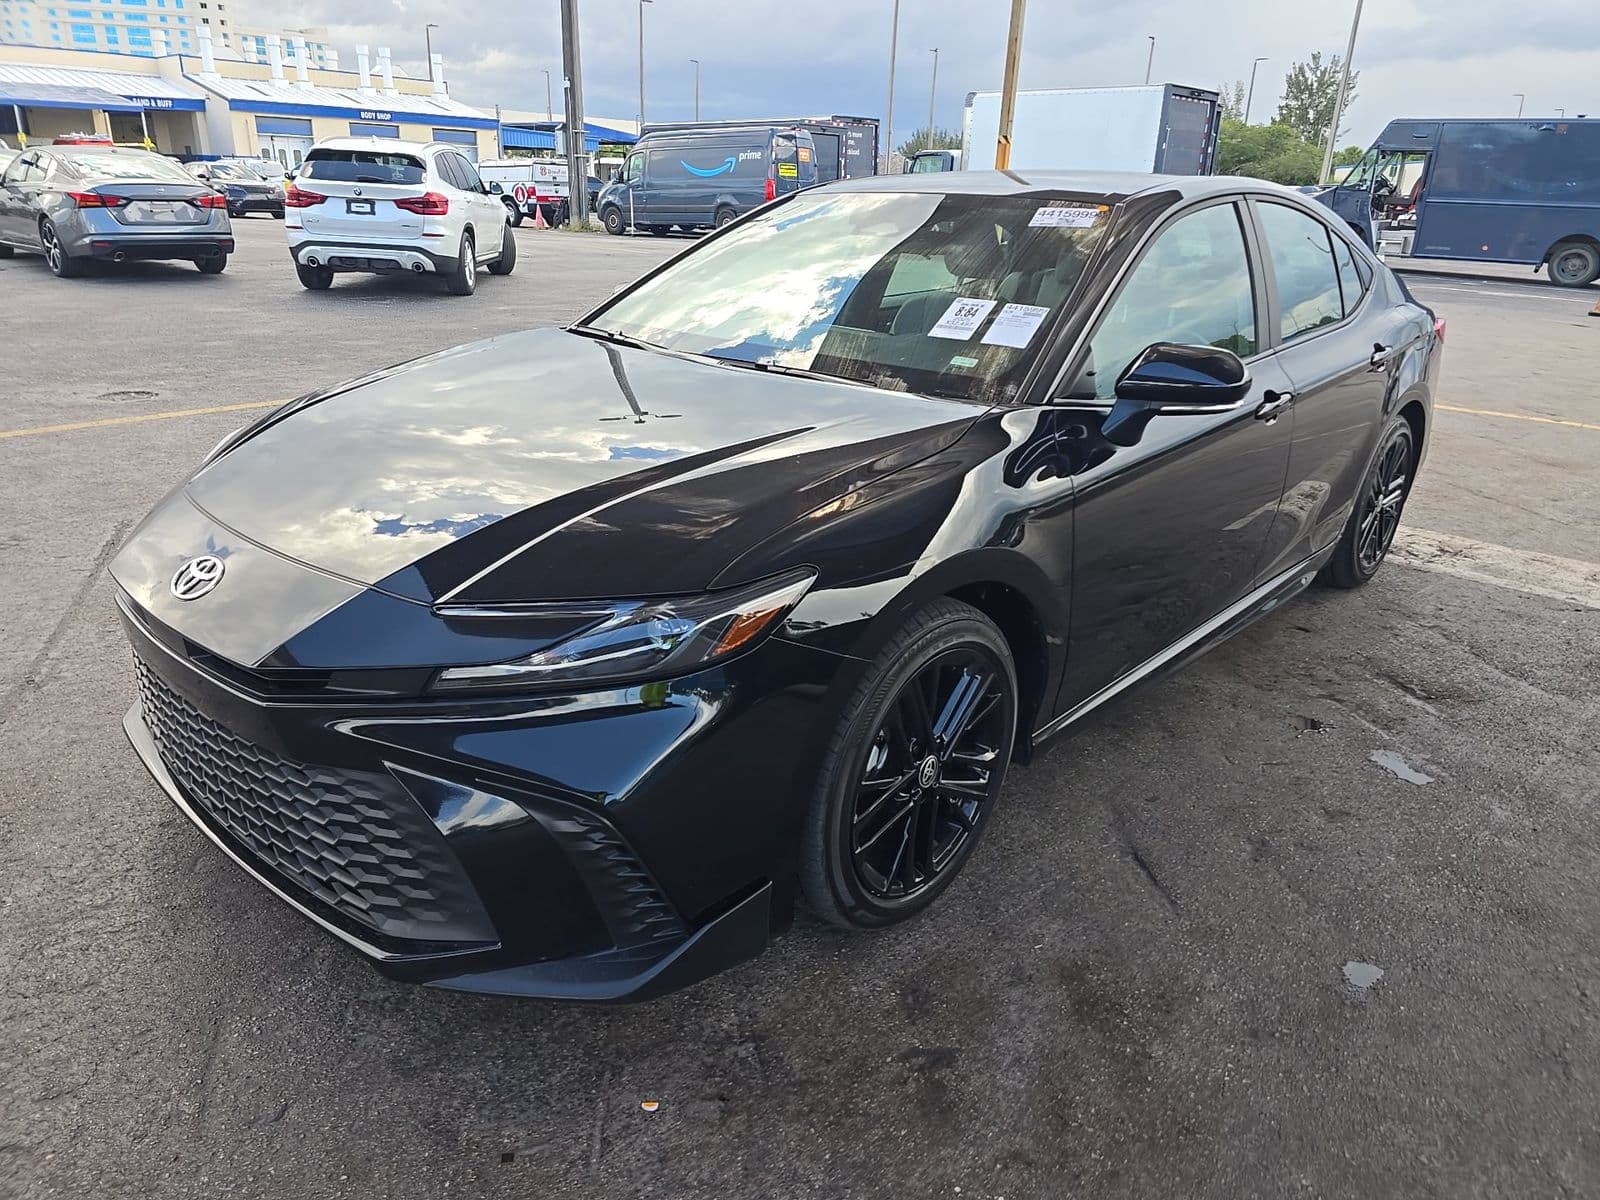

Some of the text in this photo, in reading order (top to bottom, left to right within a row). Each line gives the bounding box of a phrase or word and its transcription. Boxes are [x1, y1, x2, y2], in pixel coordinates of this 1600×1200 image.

[360, 111, 392, 121] BODY SHOP
[739, 149, 762, 162] prime
